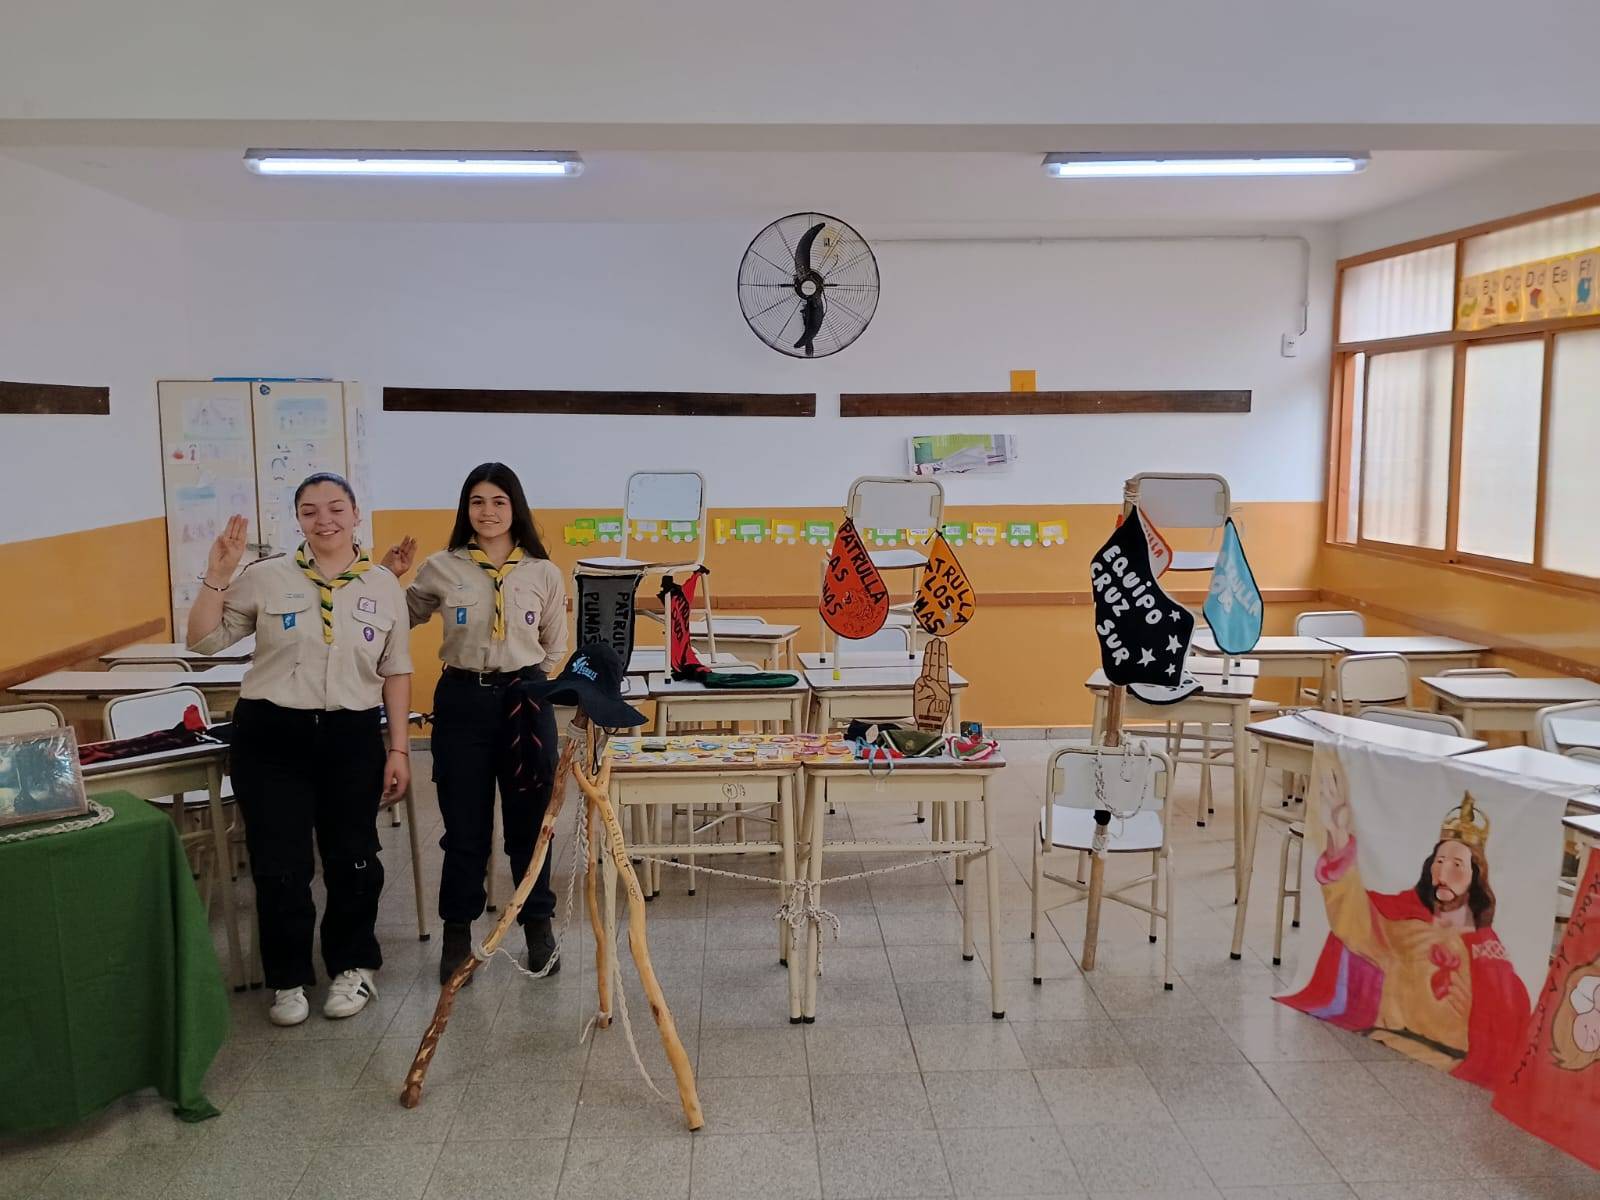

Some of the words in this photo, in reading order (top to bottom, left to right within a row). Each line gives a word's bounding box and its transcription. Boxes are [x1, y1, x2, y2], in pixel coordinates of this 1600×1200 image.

[838, 522, 887, 605] PATRULLA
[1091, 562, 1130, 617] CRUZ
[584, 591, 600, 645] PUMAS
[924, 576, 955, 611] LOS
[1096, 619, 1130, 667] SUR
